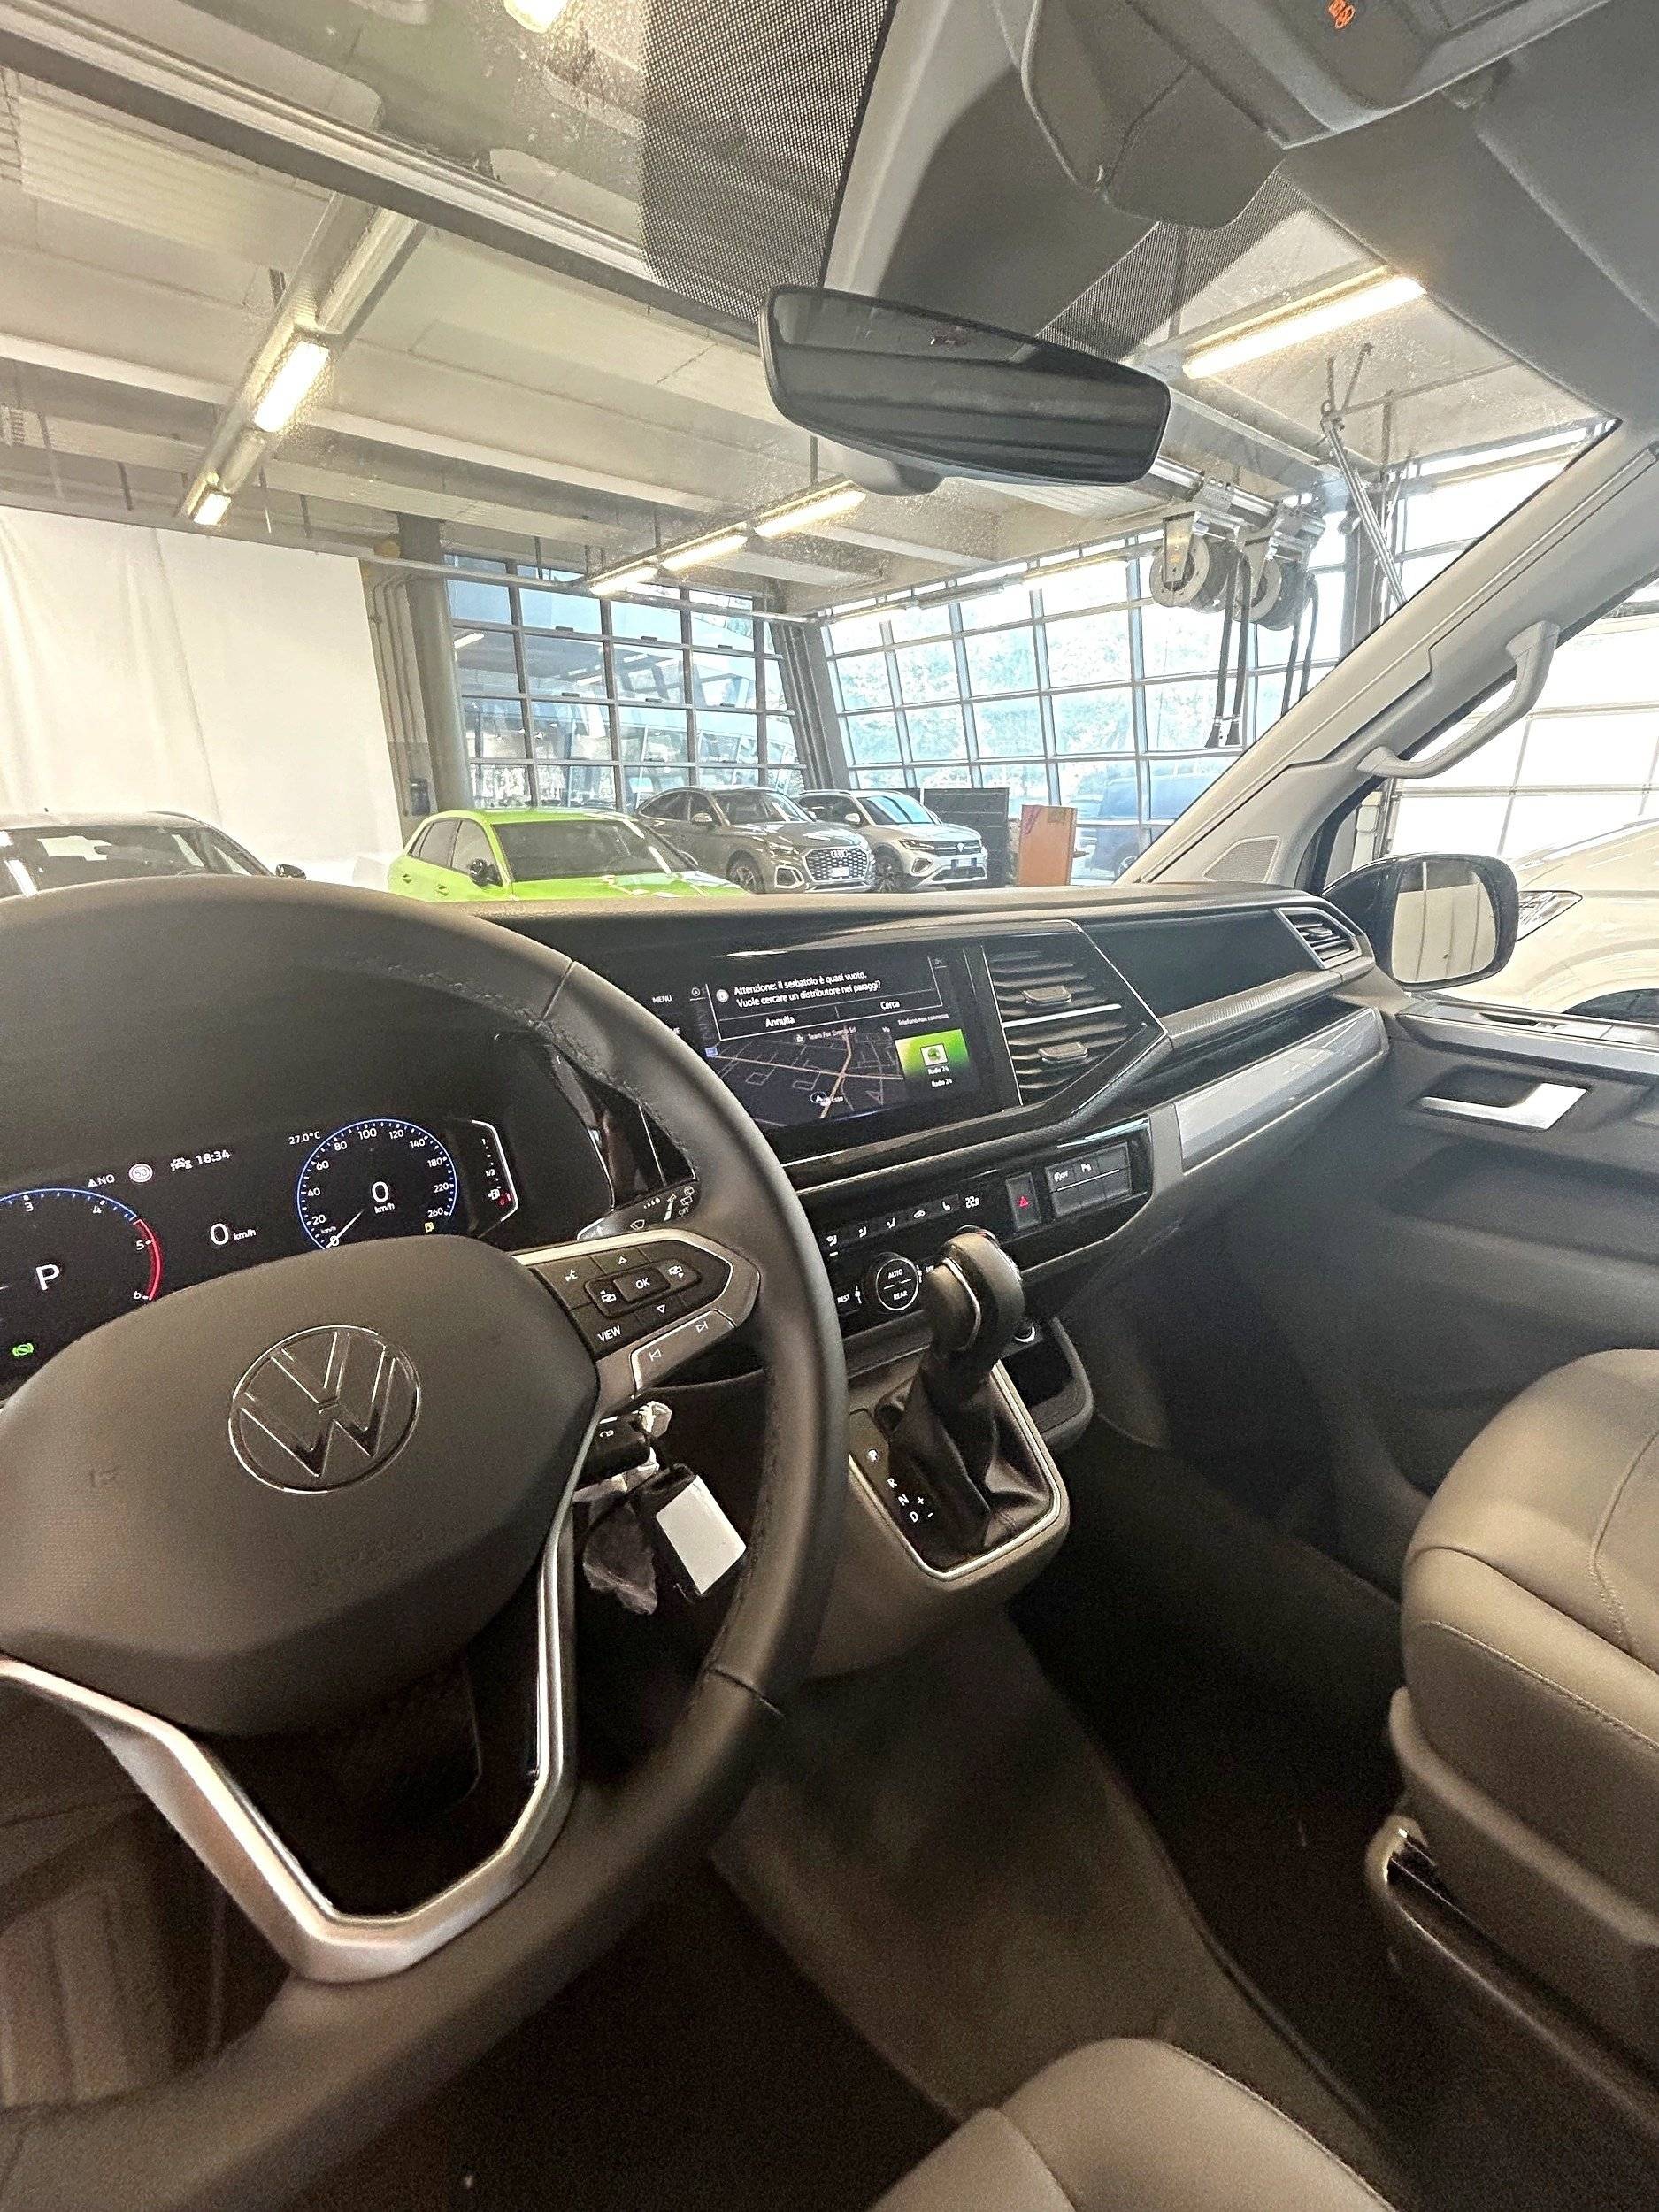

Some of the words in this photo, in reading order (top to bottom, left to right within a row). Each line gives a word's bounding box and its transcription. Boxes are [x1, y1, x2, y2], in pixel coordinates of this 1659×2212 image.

[826, 972, 845, 986] quasi
[879, 1000, 901, 1010] Cerca
[765, 1015, 795, 1028] Annulla
[357, 1128, 378, 1141] 100
[388, 1129, 405, 1140] 120
[334, 1141, 349, 1151] 80
[409, 1139, 427, 1149] 140
[195, 1149, 232, 1166] 18:34
[426, 1157, 444, 1169] 180
[315, 1160, 331, 1171] 60
[308, 1187, 322, 1197] 40
[371, 1180, 390, 1203] 0
[434, 1183, 449, 1194] 220
[24, 1202, 35, 1213] 3
[92, 1204, 102, 1215] 4
[374, 1202, 396, 1215] km/h
[427, 1207, 444, 1219] 260
[311, 1214, 327, 1225] 20
[209, 1221, 232, 1247] 0
[233, 1227, 257, 1240] km/h
[135, 1240, 144, 1251] 5
[35, 1263, 61, 1292] P
[887, 1269, 903, 1279] AUTO
[635, 1278, 650, 1290] OK
[133, 1290, 142, 1301] 6
[597, 1325, 621, 1342] VIEW
[887, 1478, 897, 1488] R
[897, 1493, 910, 1507] N
[908, 1510, 920, 1524] D
